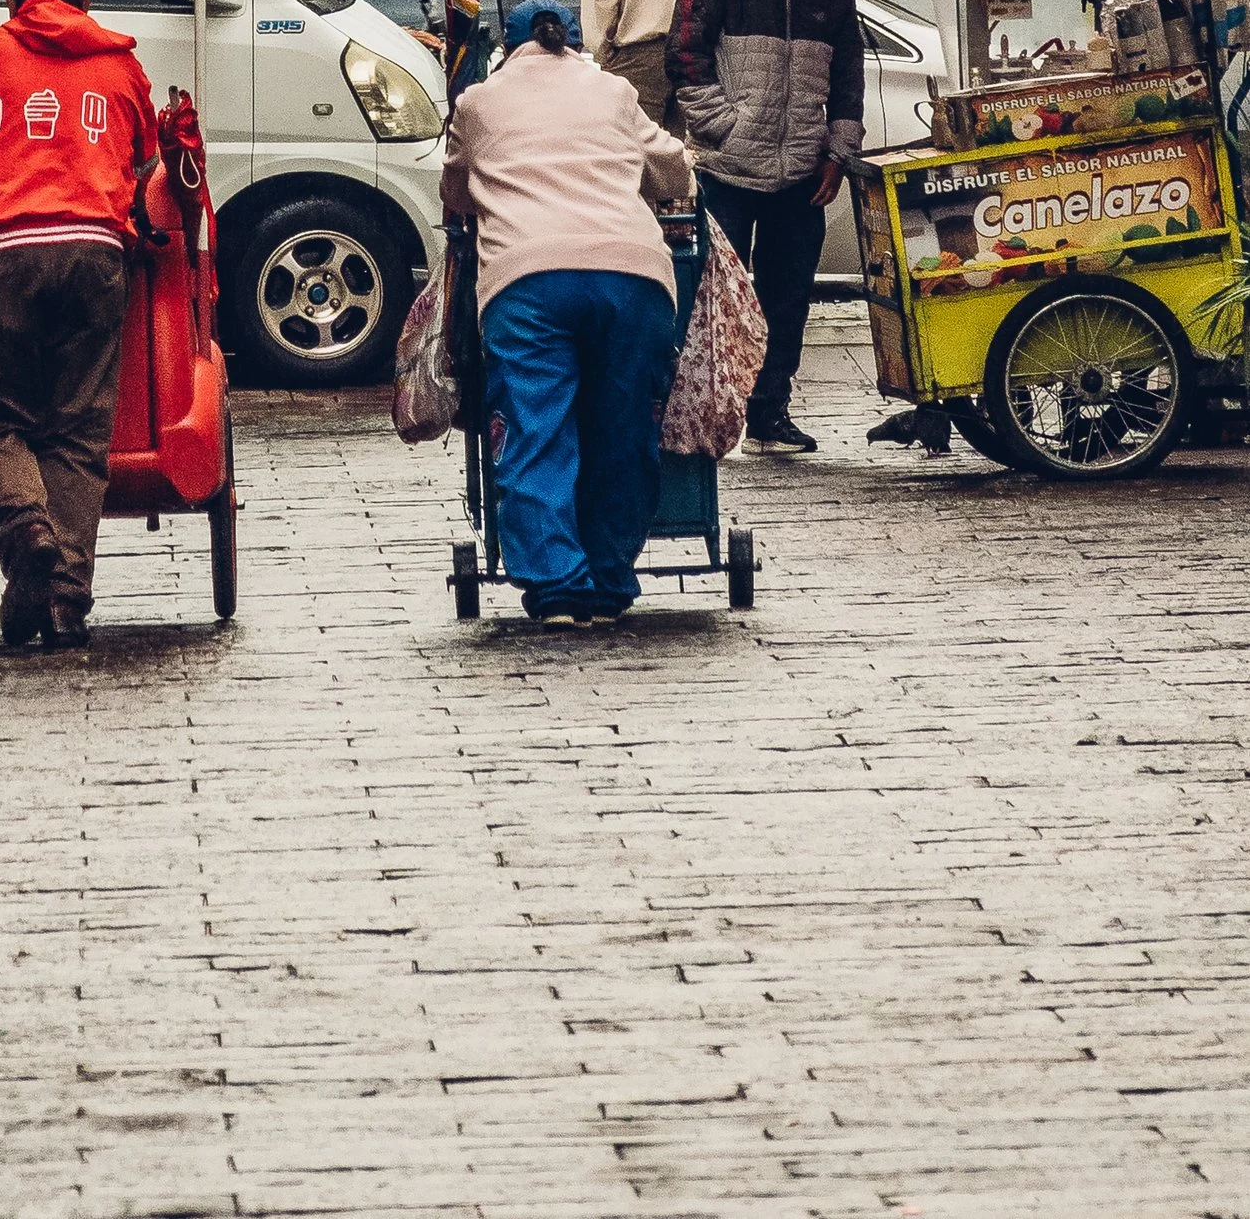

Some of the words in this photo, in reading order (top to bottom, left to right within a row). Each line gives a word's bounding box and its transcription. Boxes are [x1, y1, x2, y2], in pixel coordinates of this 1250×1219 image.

[981, 95, 1046, 113] DISFRUTE
[1048, 91, 1064, 103] EL
[1068, 85, 1111, 101] SABOR
[1115, 77, 1173, 95] NATURAL
[924, 171, 1010, 194] DISFRUTE
[1016, 168, 1037, 182] EL
[1041, 158, 1102, 178] SABOR
[1107, 145, 1187, 168] NATURAL
[973, 174, 1191, 238] Canelazo
